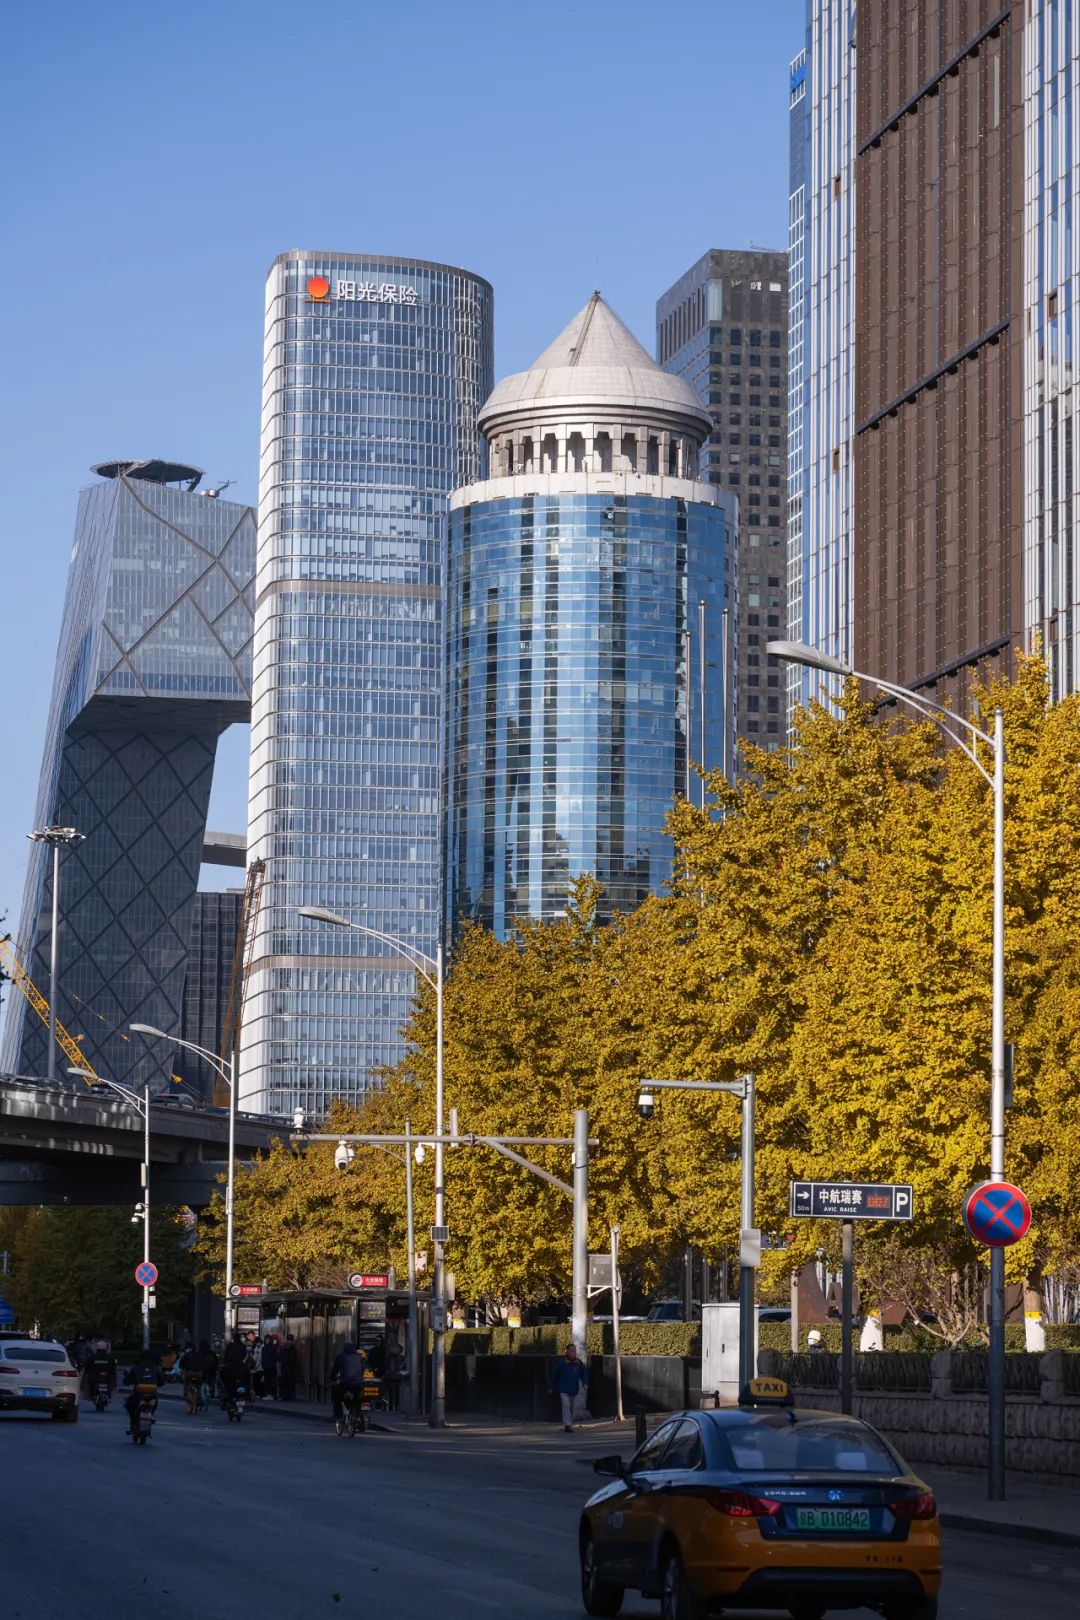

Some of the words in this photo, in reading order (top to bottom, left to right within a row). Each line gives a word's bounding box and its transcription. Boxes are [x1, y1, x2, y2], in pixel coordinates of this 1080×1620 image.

[336, 279, 418, 306] 阳光保险
[819, 1188, 863, 1205] 中航瑞赛
[896, 1192, 909, 1213] P
[755, 1383, 784, 1393] TAXI
